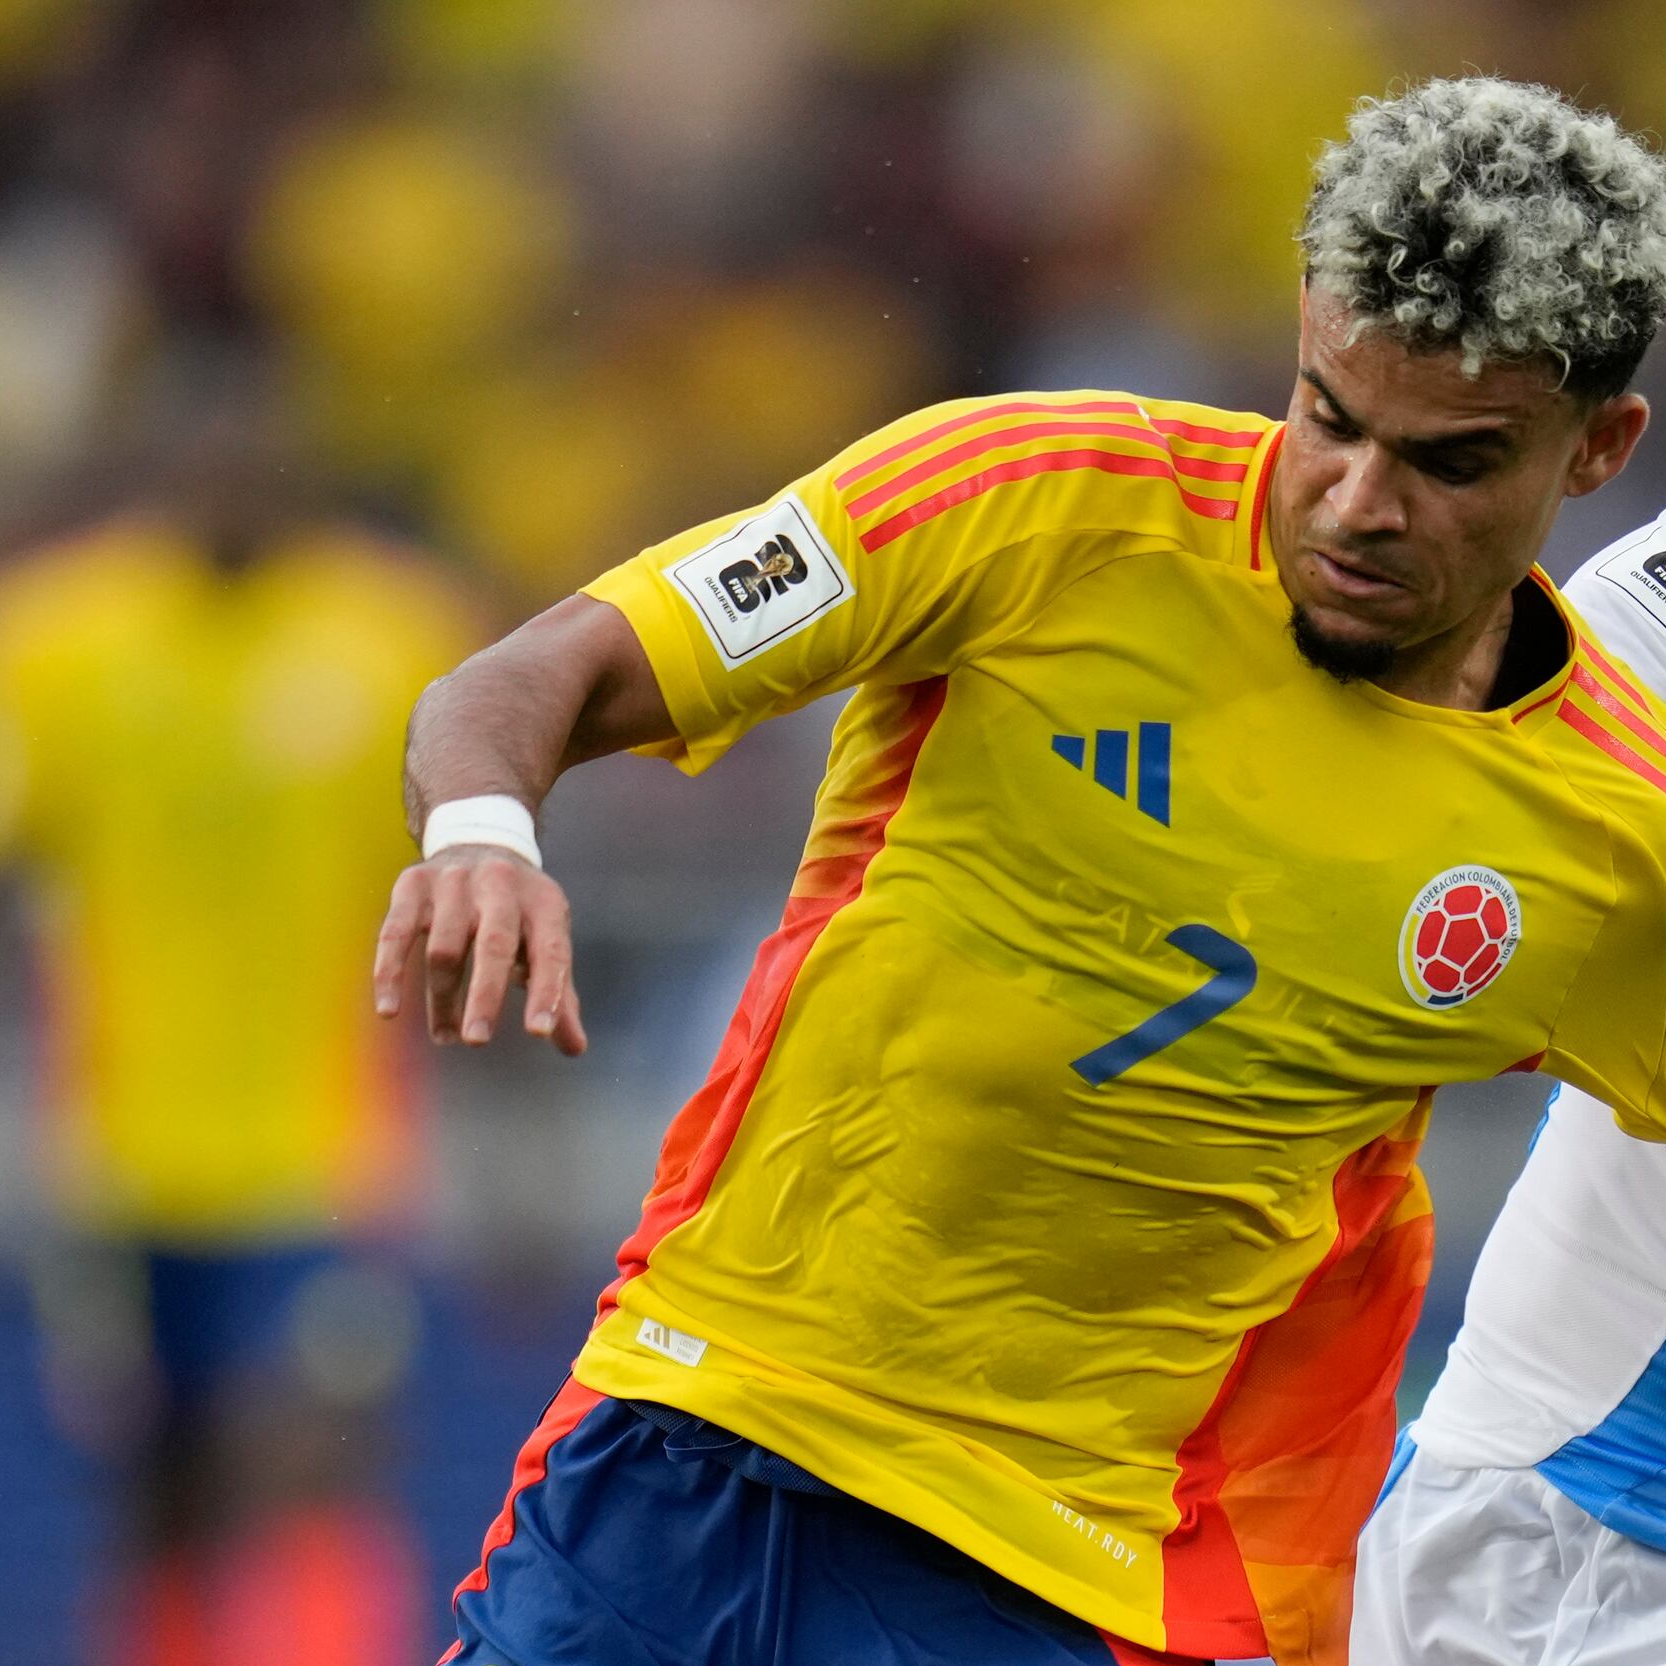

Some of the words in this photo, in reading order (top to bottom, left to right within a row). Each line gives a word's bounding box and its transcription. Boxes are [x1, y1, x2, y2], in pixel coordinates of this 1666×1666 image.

[704, 576, 738, 623] QUALIFIERS
[728, 577, 749, 603] FIFA
[1467, 871, 1514, 908] COLOMBIANA
[1069, 924, 1257, 1088] 7
